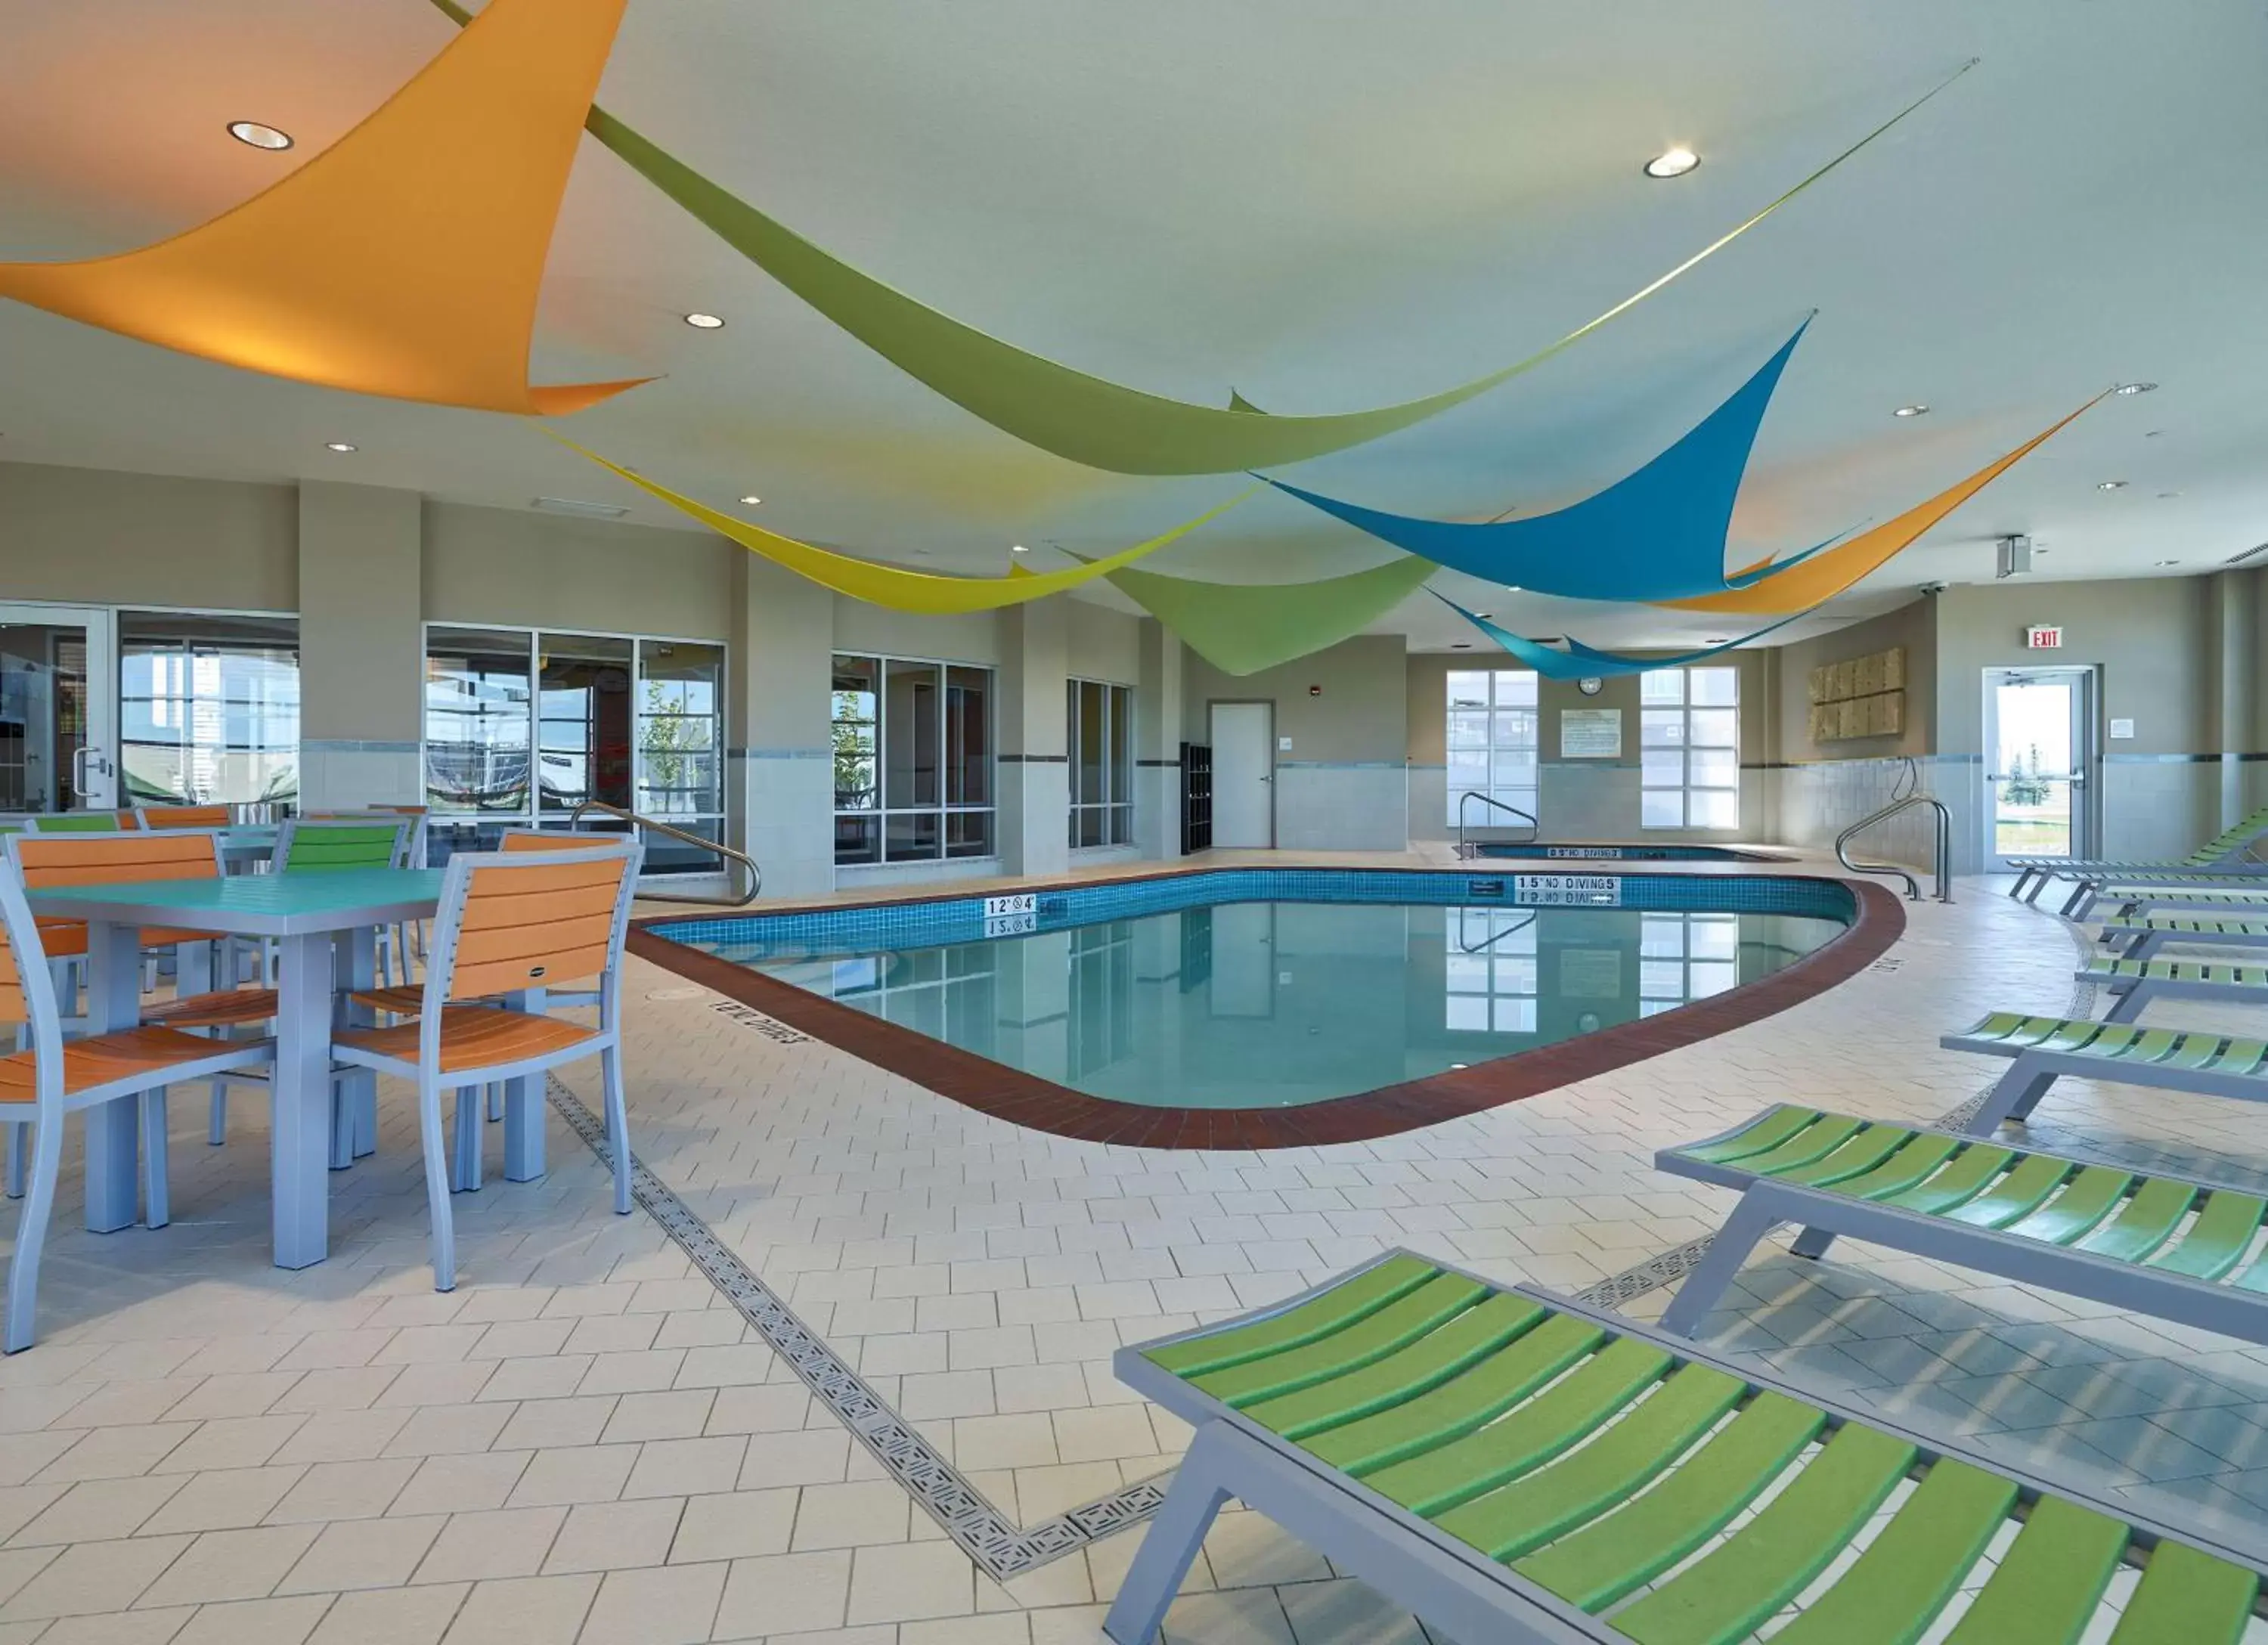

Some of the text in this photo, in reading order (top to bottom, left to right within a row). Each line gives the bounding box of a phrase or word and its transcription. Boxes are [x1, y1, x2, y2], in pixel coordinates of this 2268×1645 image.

[2033, 630, 2058, 646] EXIT
[1545, 877, 1559, 889] NO
[1566, 878, 1604, 890] DIVING
